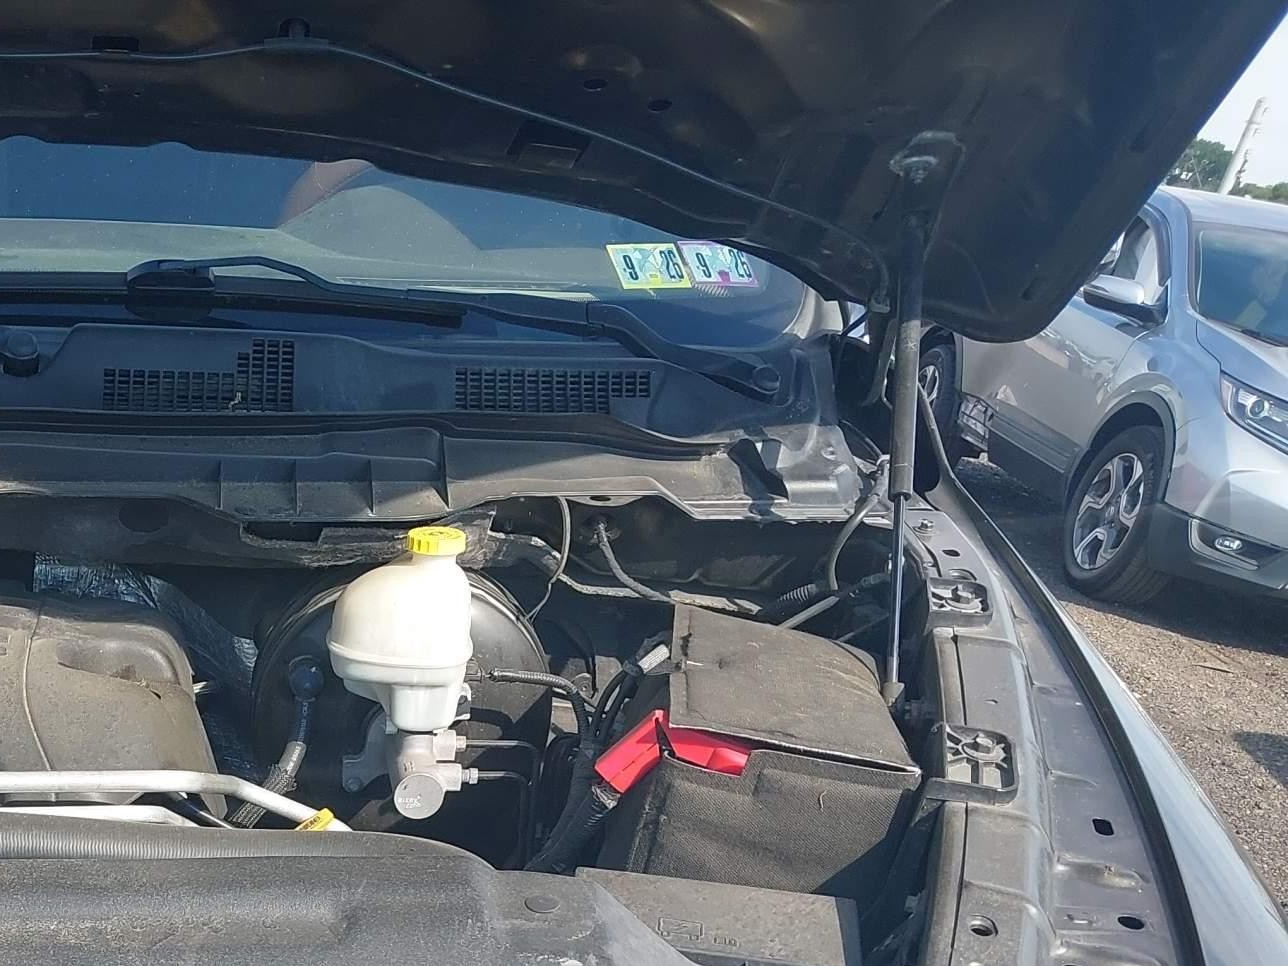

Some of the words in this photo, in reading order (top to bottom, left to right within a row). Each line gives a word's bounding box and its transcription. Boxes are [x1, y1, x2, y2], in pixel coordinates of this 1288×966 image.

[622, 254, 639, 281] 9
[659, 249, 684, 280] 26
[695, 252, 712, 278] 9
[728, 248, 752, 278] 26
